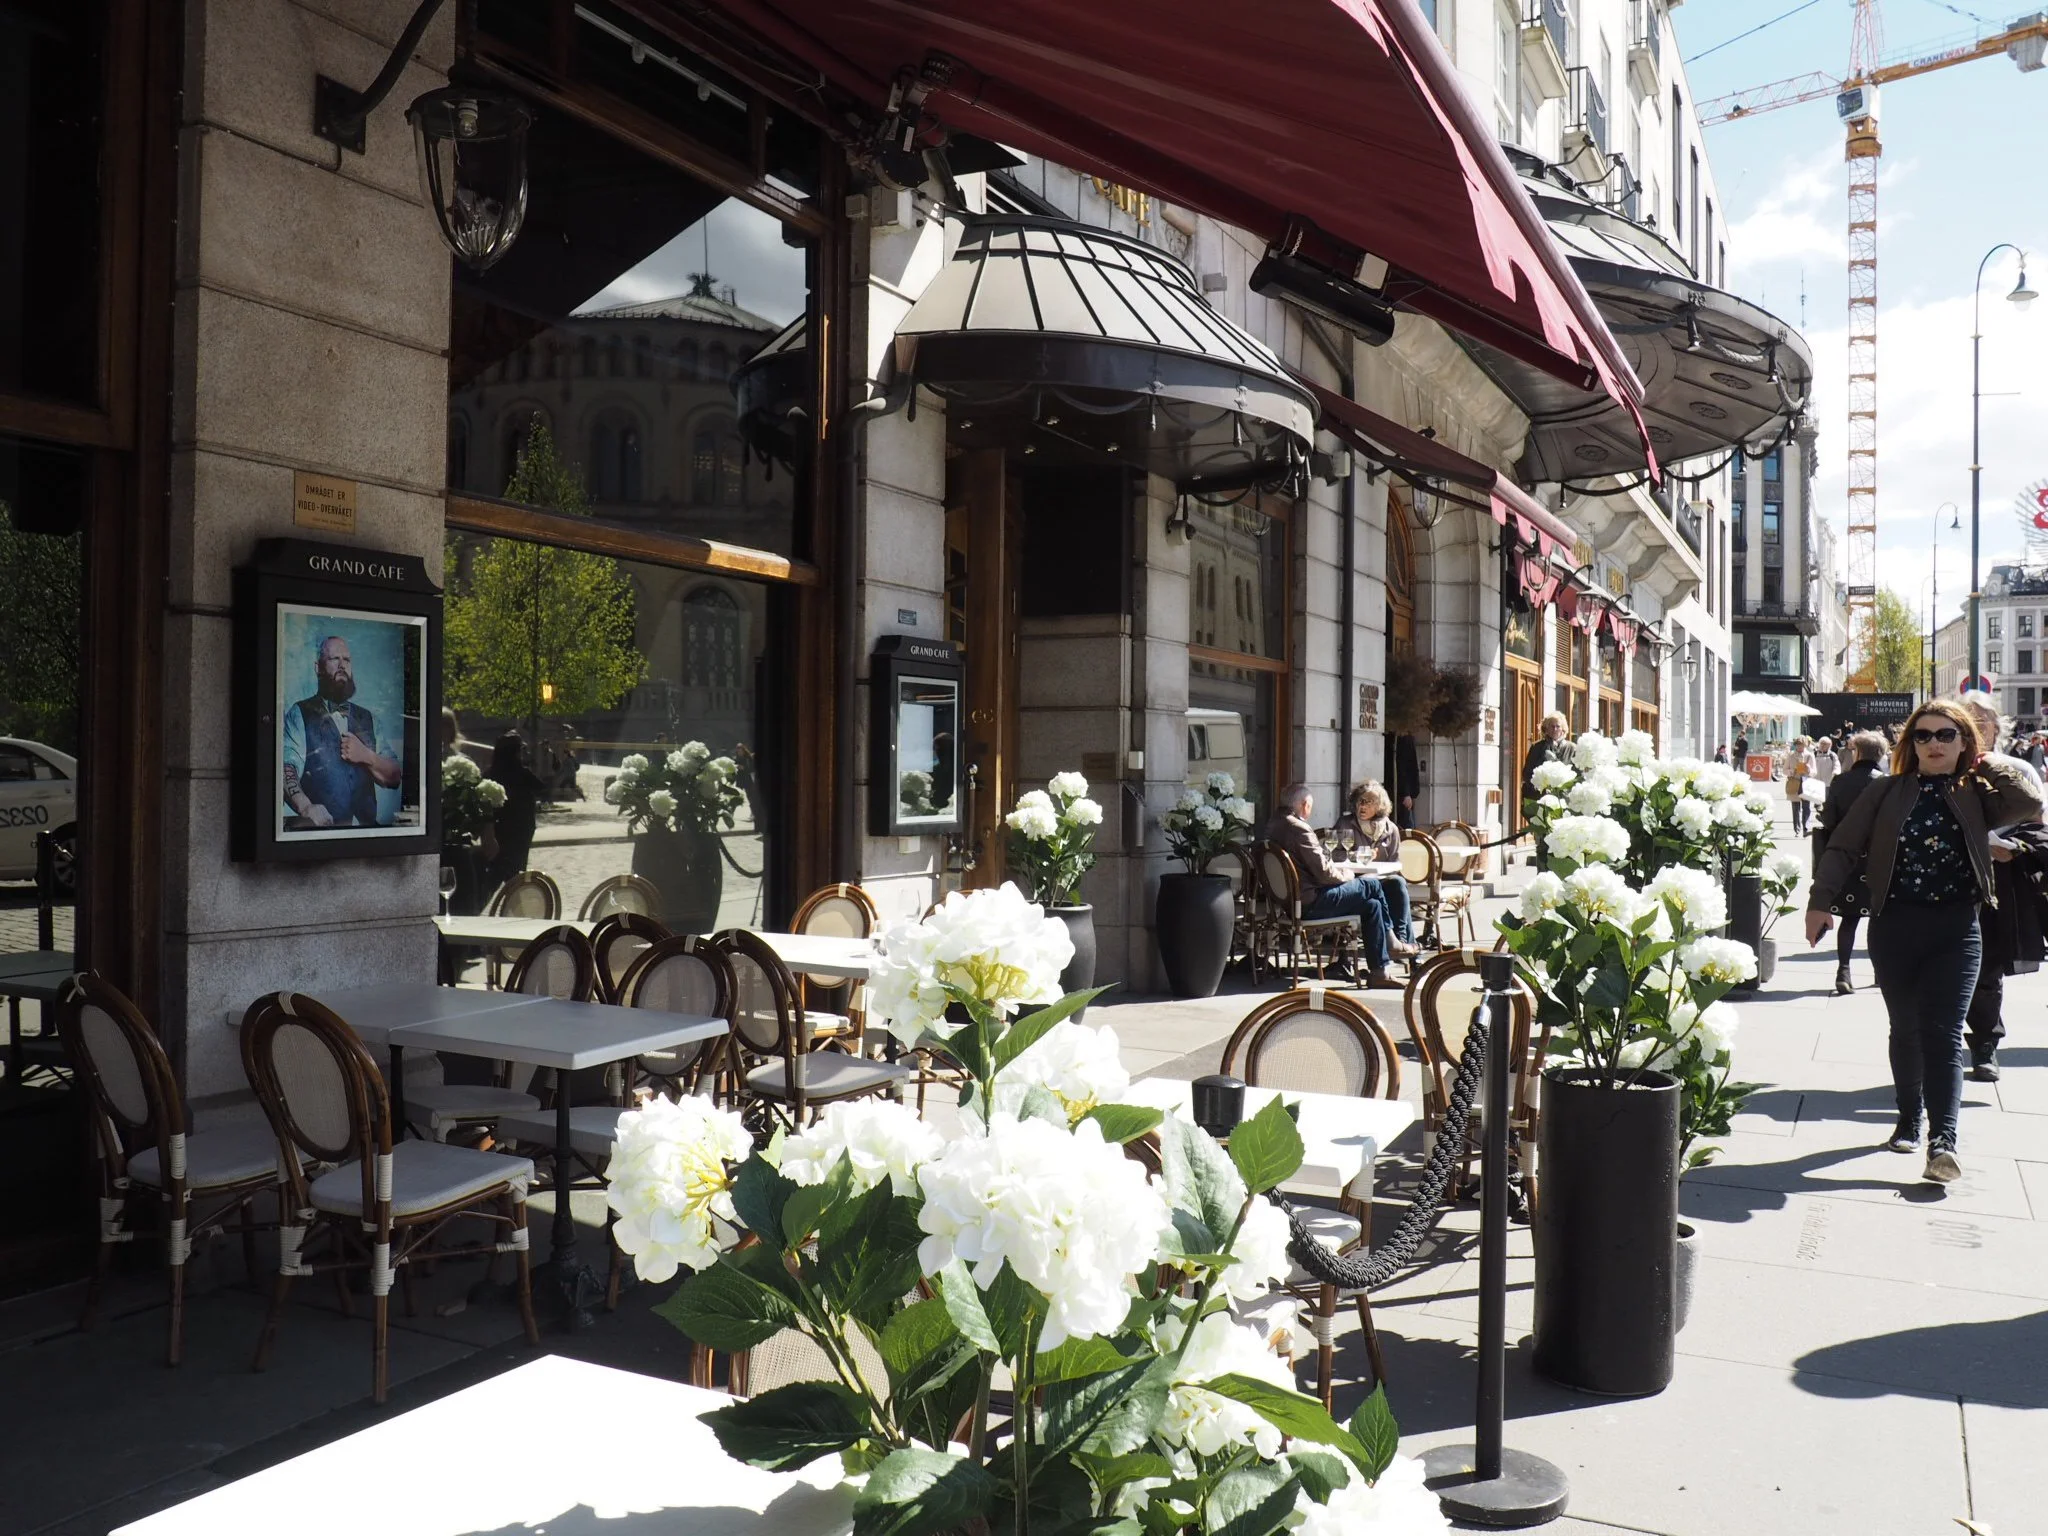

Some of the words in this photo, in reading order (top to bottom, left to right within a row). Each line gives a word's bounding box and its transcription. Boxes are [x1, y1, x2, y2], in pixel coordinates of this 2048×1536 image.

[1913, 47, 1966, 67] CRANEWAY
[308, 555, 365, 575] GRAND
[368, 563, 405, 581] CAFE
[910, 645, 933, 657] GRAND
[933, 648, 950, 660] CAFE
